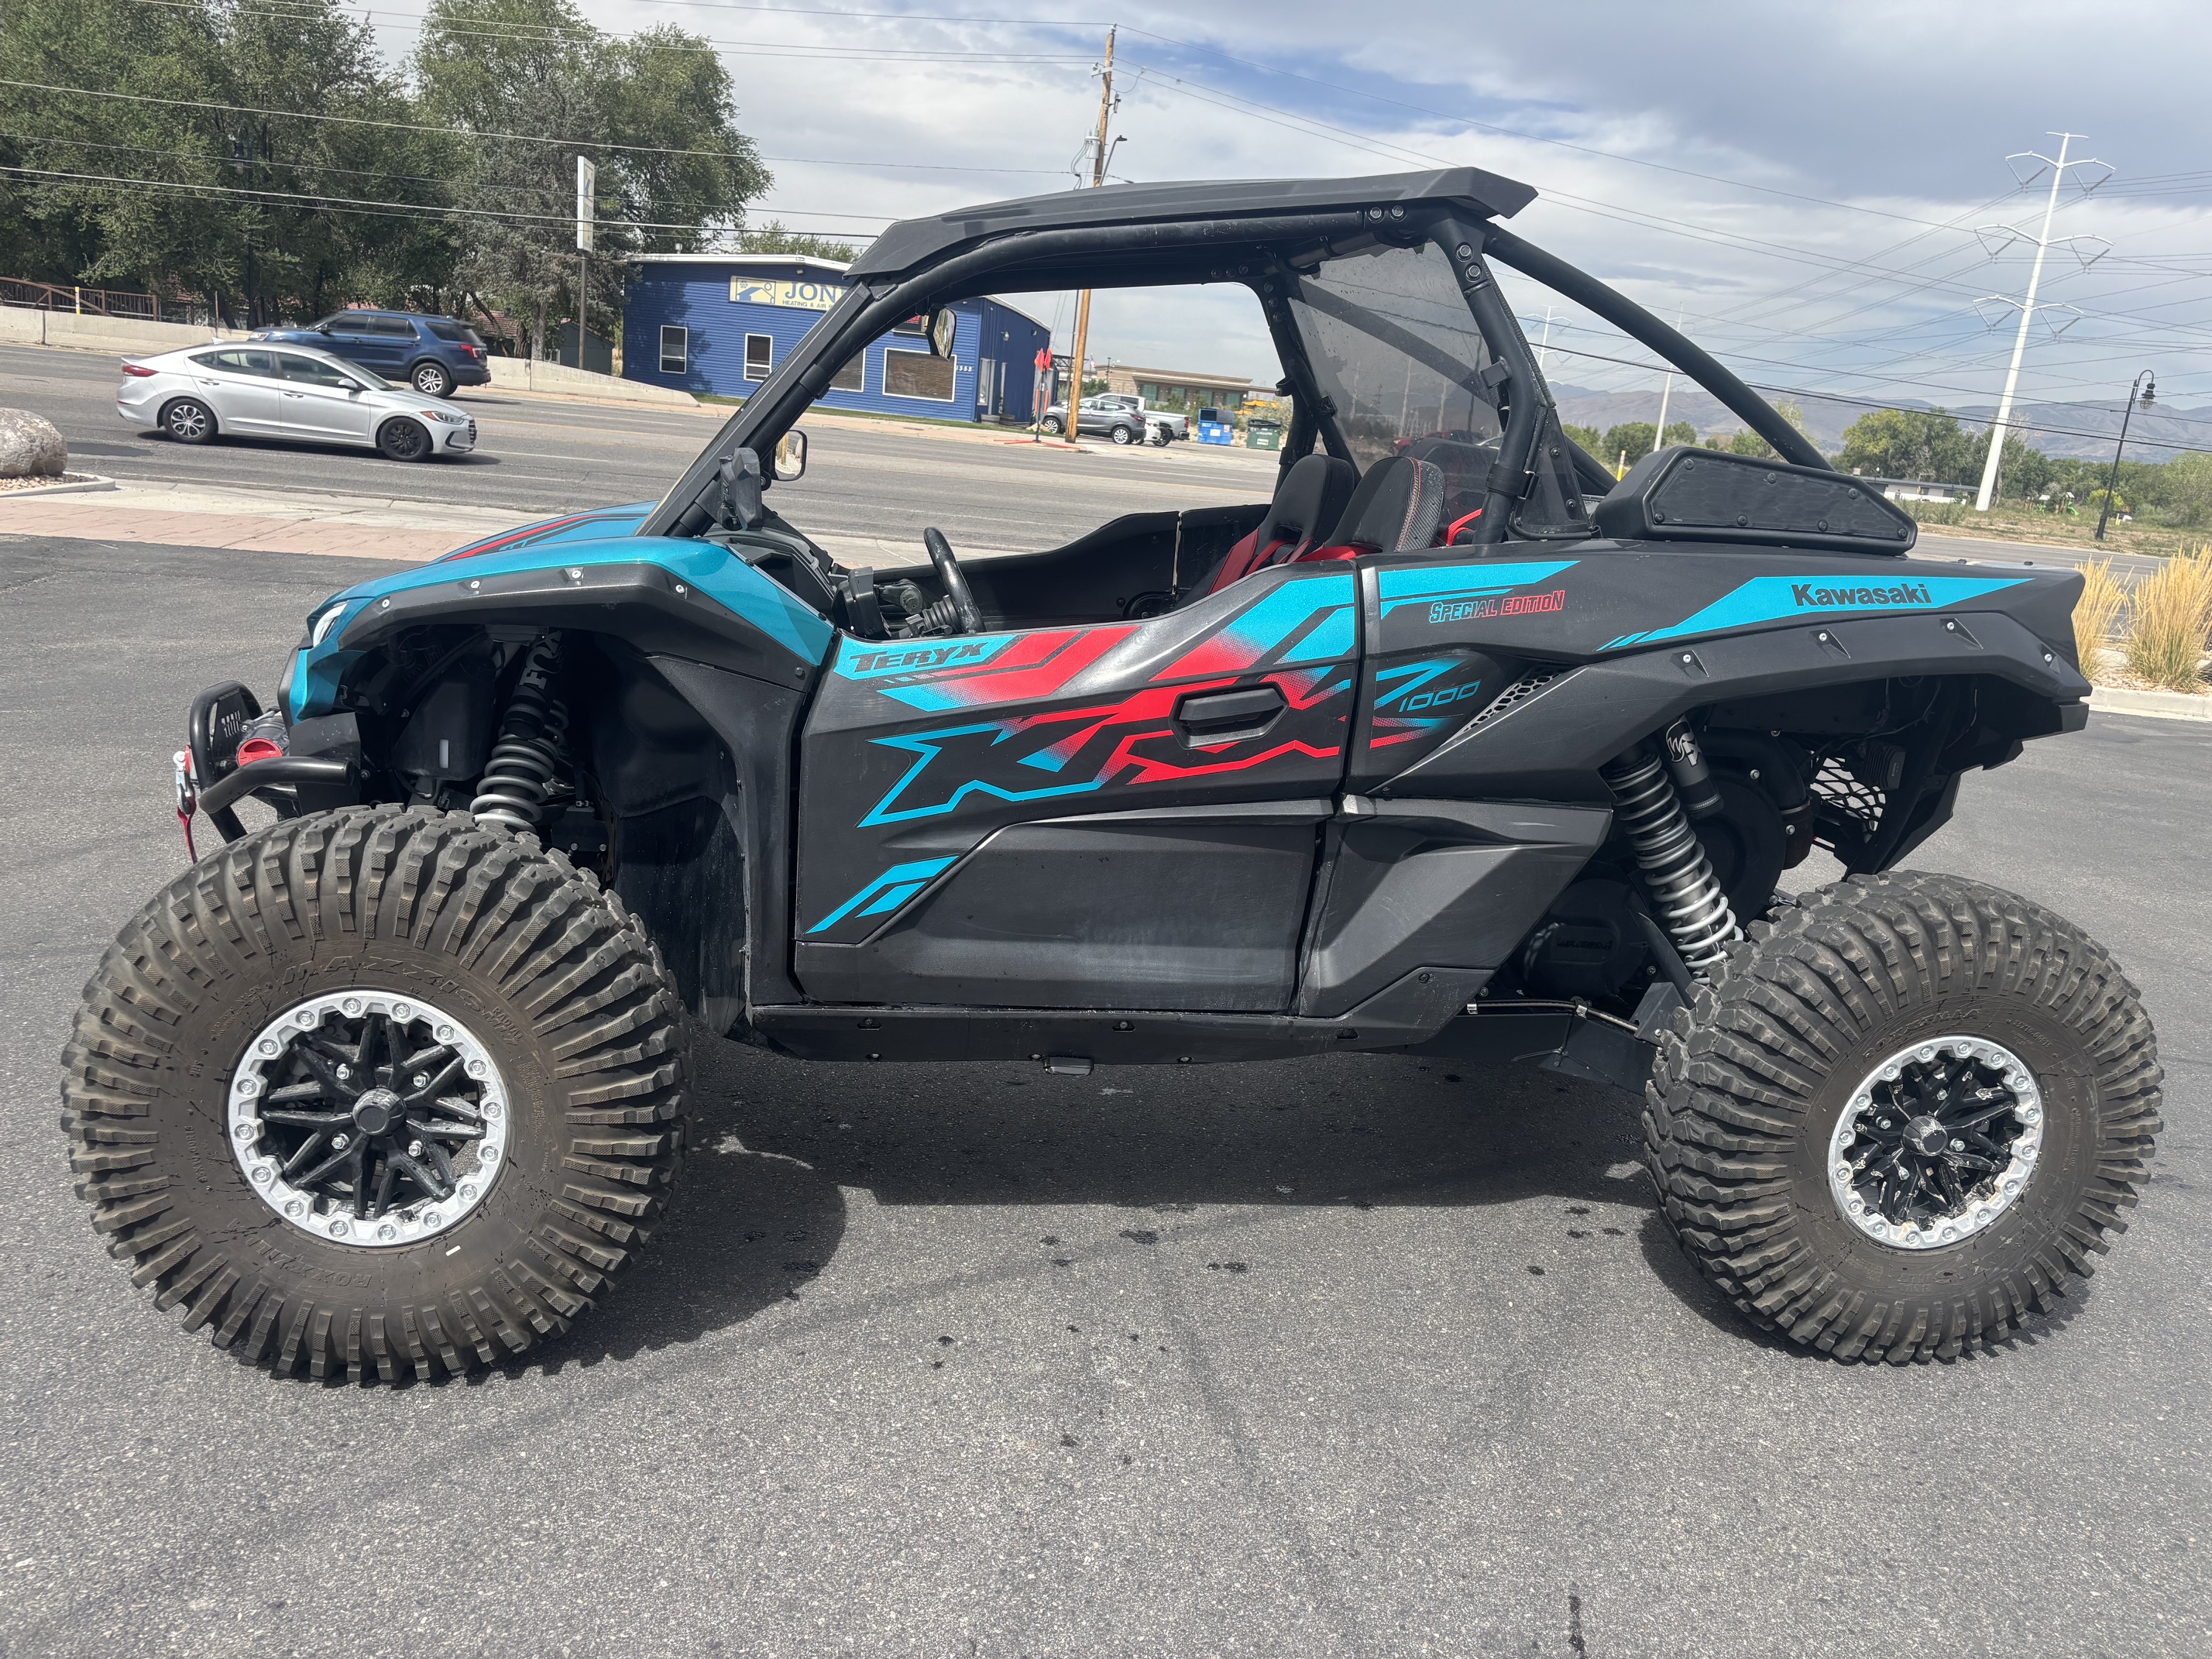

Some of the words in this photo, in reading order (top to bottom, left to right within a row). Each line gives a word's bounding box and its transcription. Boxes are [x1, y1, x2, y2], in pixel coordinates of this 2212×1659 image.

[785, 282, 847, 304] JON
[1428, 599, 1498, 623] SPECIAL
[1500, 589, 1566, 616] EDITION
[1791, 583, 1932, 606] Kawasaki
[850, 641, 989, 673] TERYX
[1398, 679, 1481, 713] 1000
